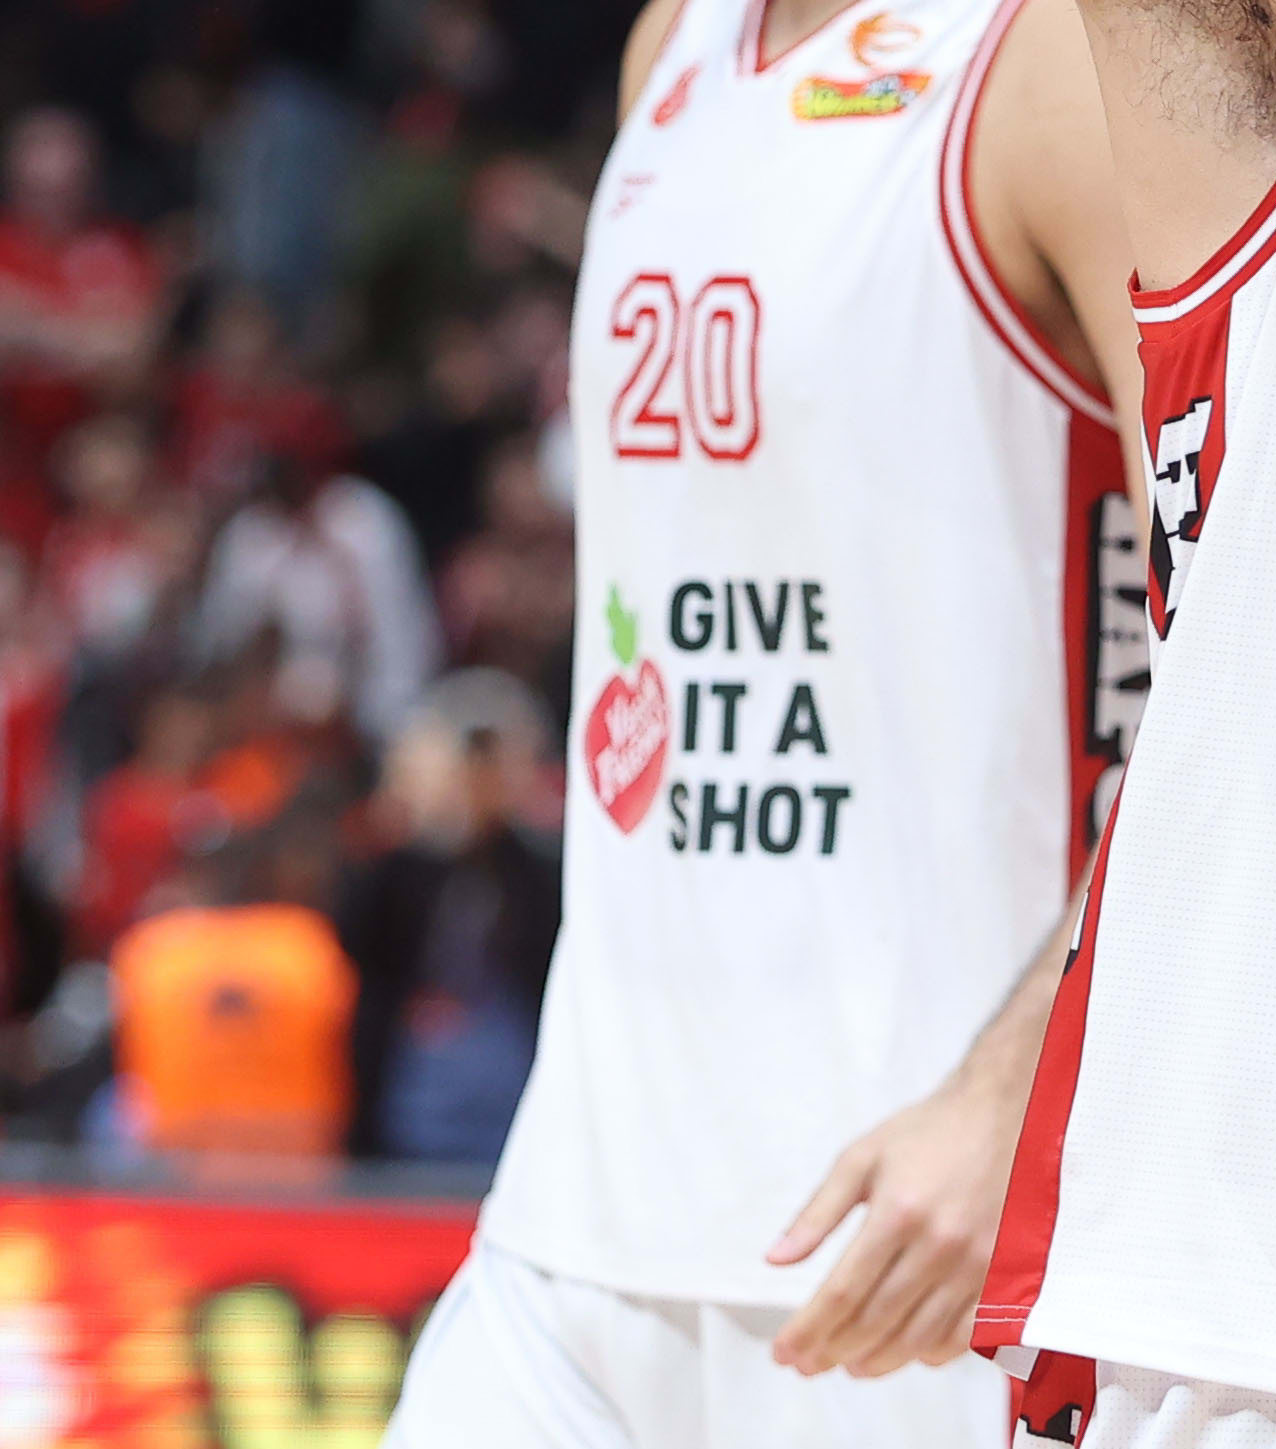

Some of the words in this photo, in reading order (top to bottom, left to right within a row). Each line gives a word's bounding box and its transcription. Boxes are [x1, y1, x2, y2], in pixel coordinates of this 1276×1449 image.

[610, 270, 762, 461] 20
[667, 580, 830, 655] GIVE
[681, 682, 747, 754] IT
[774, 683, 829, 755] A
[668, 782, 853, 856] SHOT
